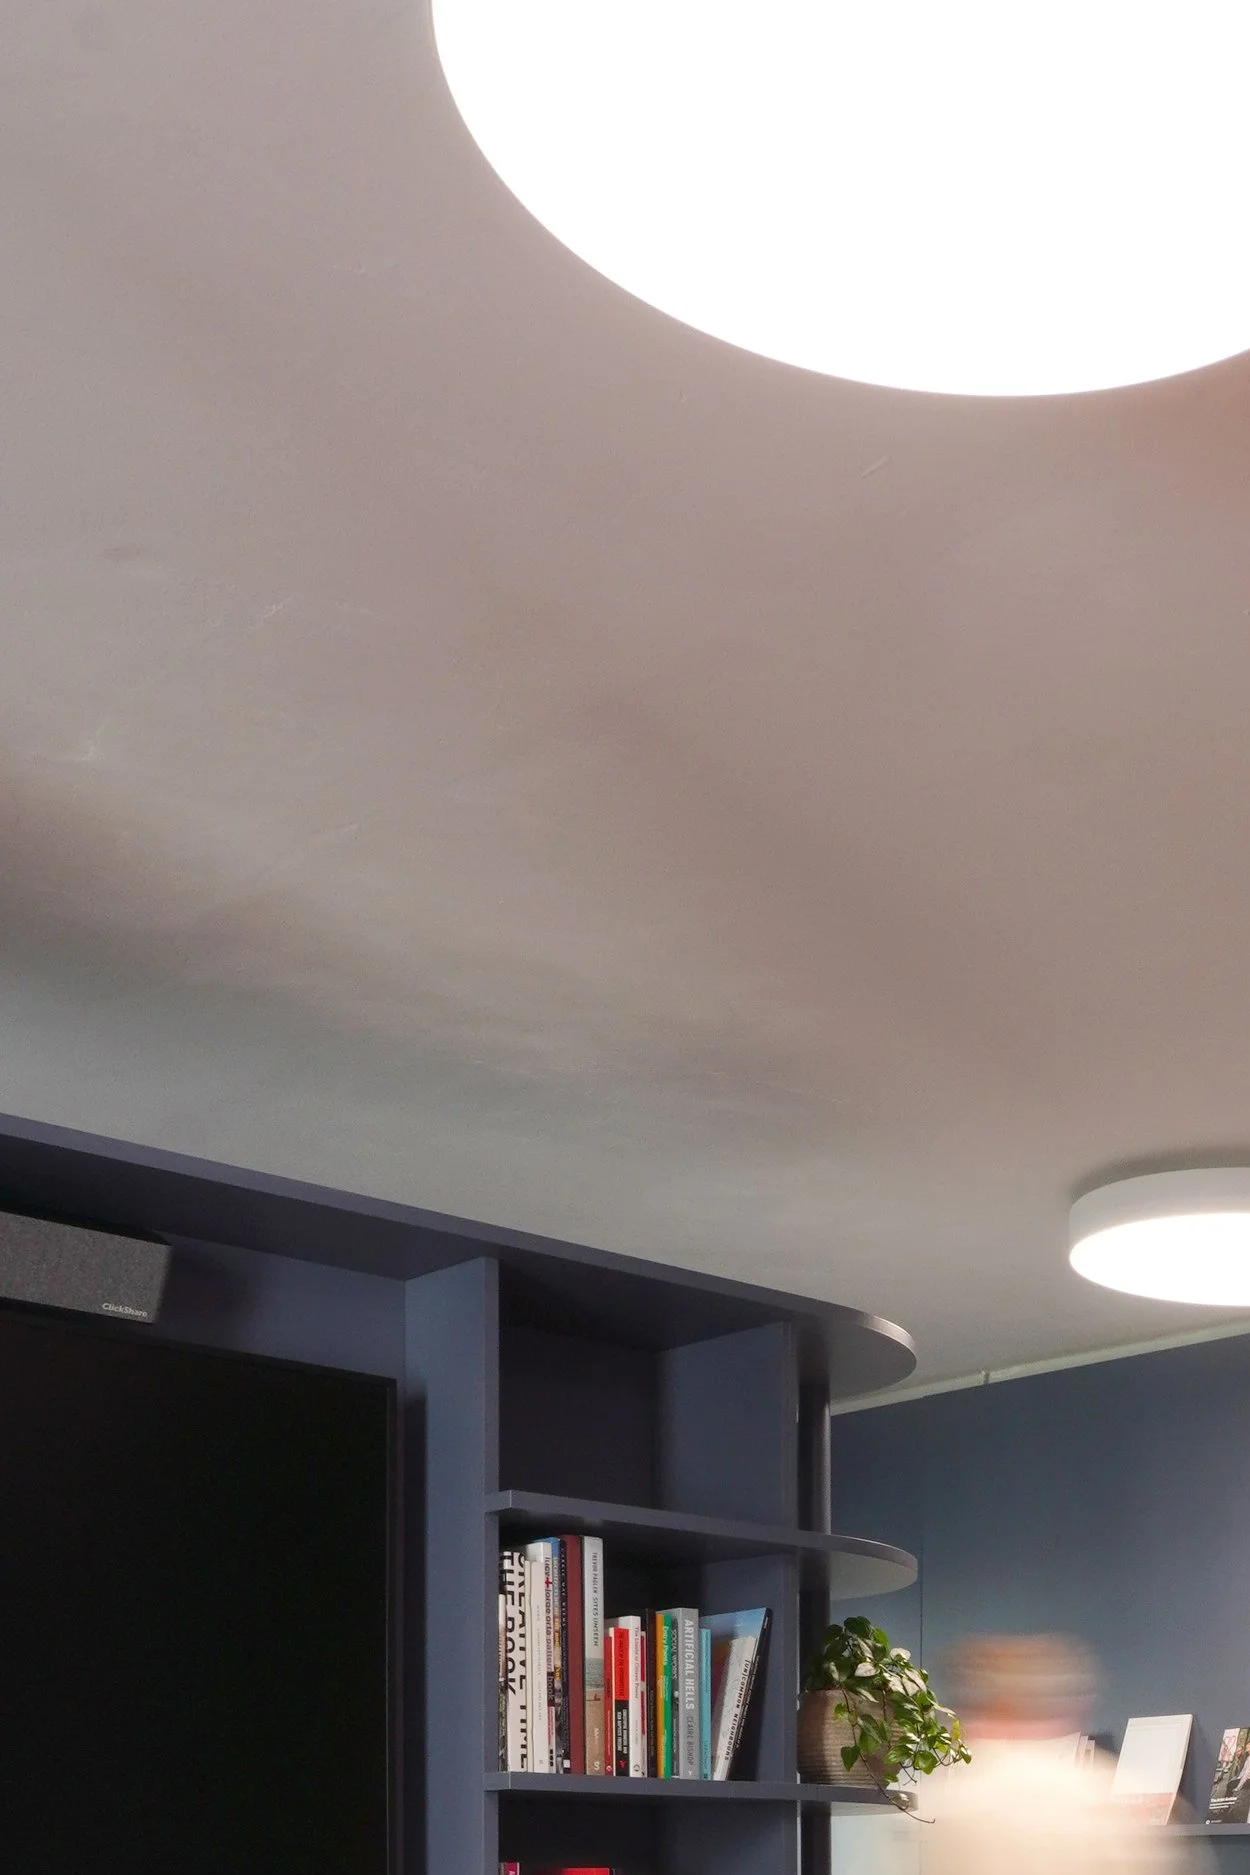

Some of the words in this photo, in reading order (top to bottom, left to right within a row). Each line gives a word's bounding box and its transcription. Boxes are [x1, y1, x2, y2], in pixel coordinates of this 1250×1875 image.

[101, 1302, 148, 1318] ClickShare
[591, 1552, 599, 1572] TREVOR
[591, 1572, 599, 1596] PAGLEN
[591, 1596, 600, 1616] SITES
[592, 1616, 600, 1648] UNSEEN
[684, 1618, 695, 1676] ARTIFICIAL
[546, 1676, 555, 1702] book
[685, 1678, 695, 1710] HELLS
[735, 1660, 751, 1709] [UN]COMMON
[685, 1716, 695, 1738] CLAIRE
[724, 1712, 740, 1760] NEIGHBOURS
[686, 1740, 695, 1766] BISHOP
